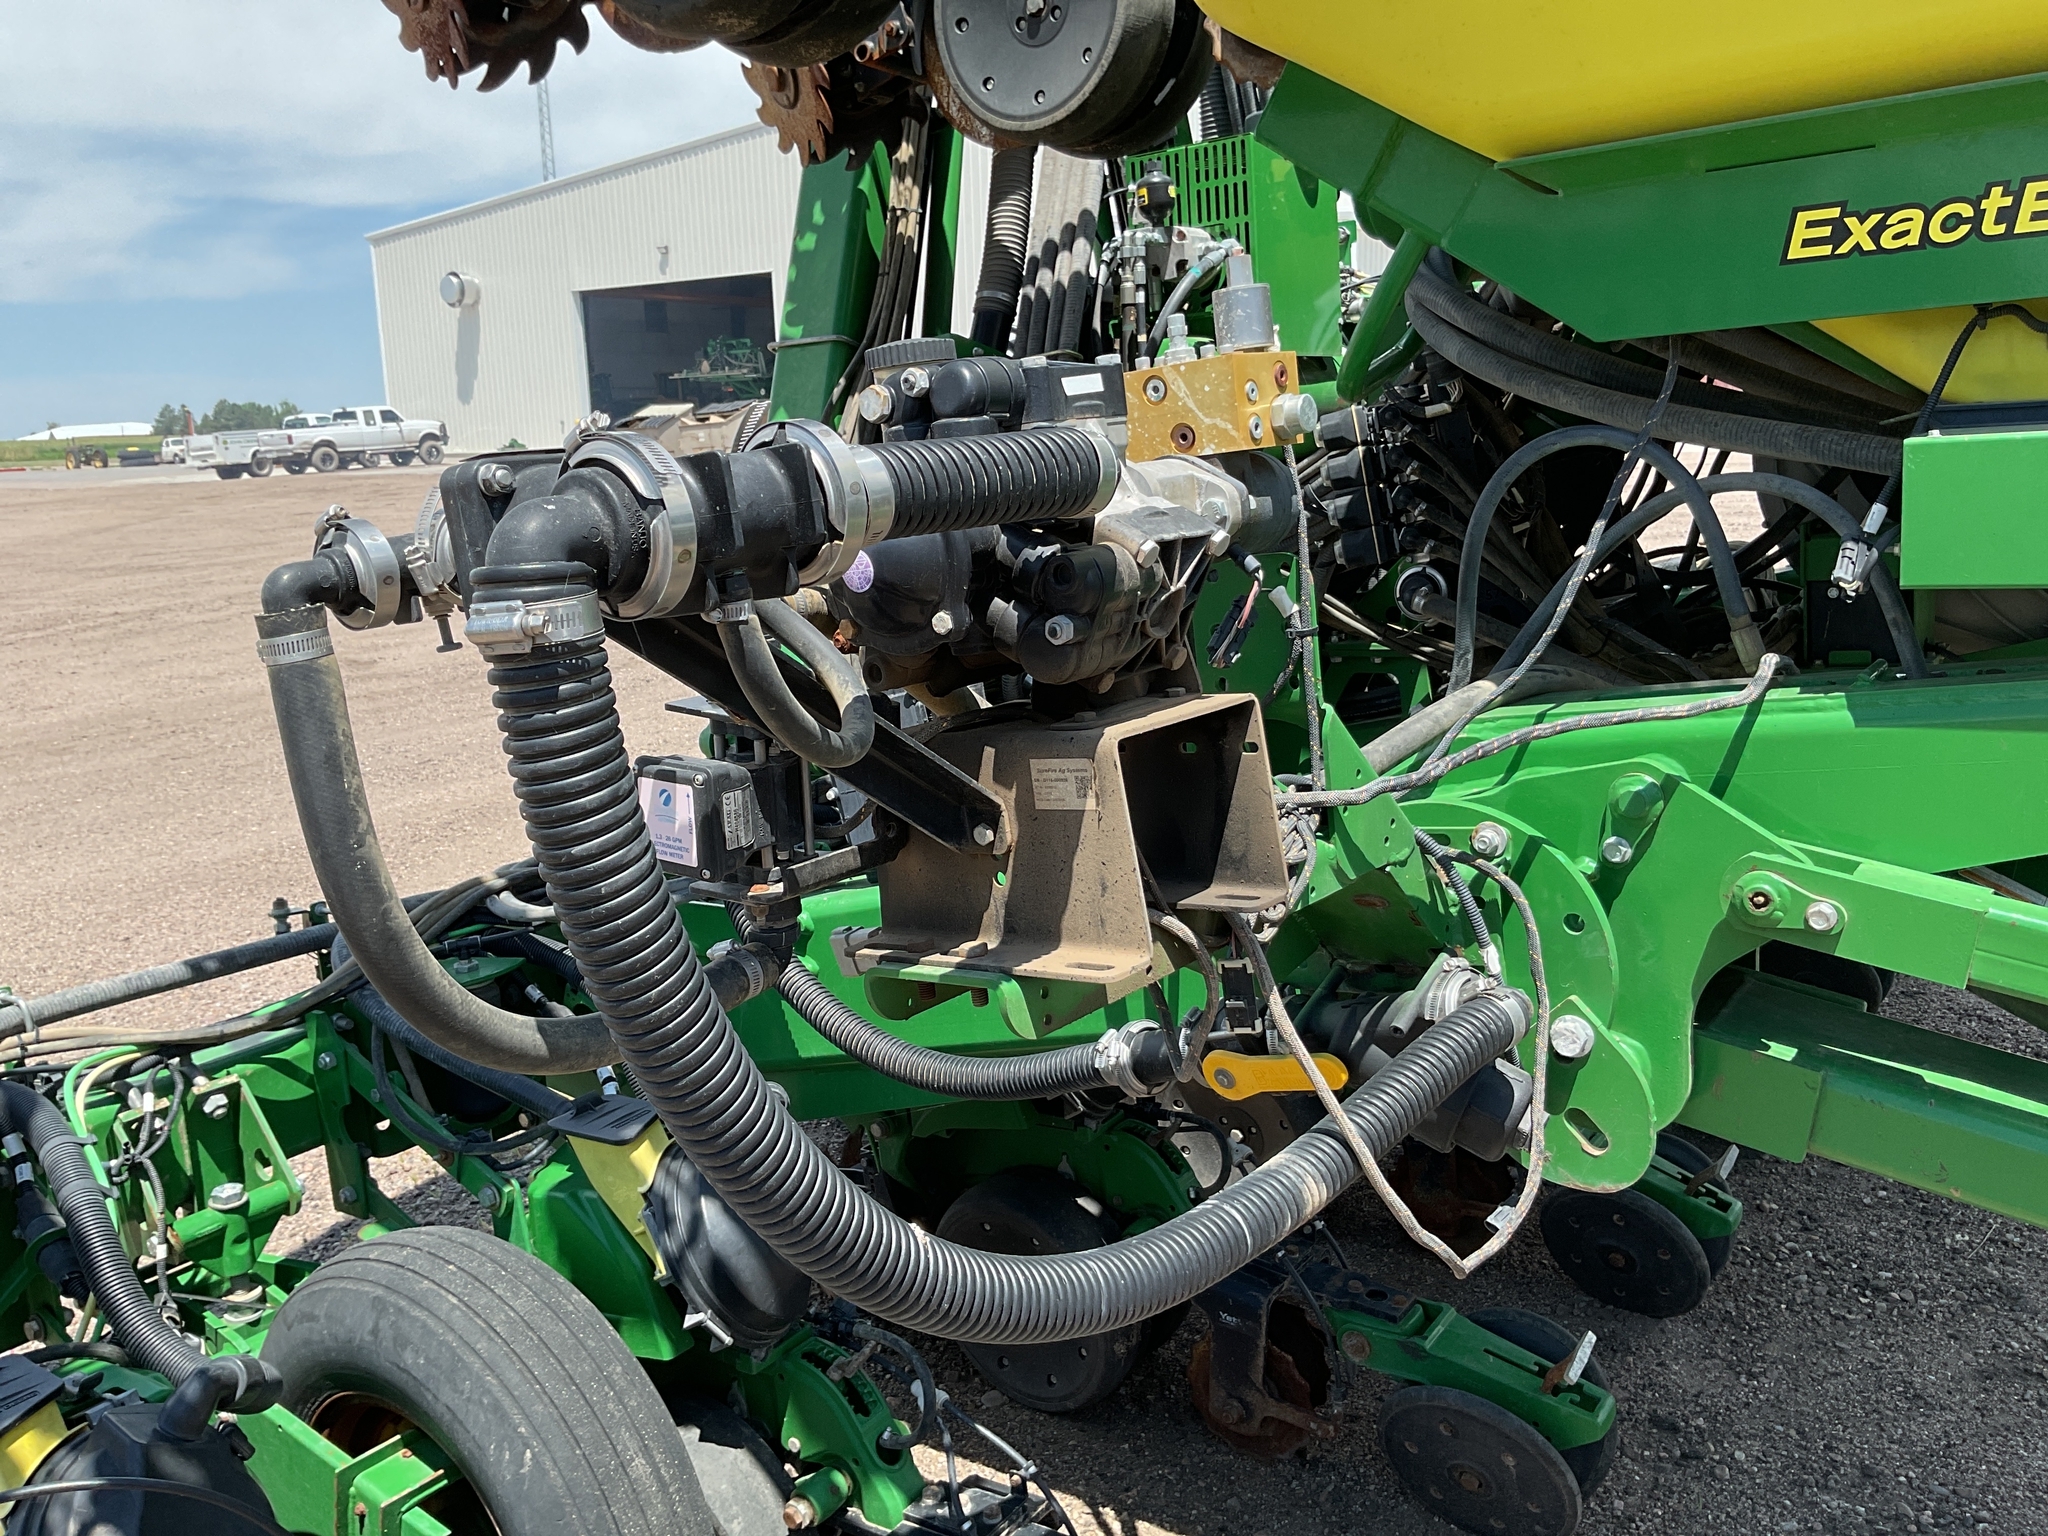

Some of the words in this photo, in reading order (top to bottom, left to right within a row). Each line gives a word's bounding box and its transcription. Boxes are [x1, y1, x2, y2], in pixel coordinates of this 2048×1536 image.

[634, 509, 647, 549] BANJO
[672, 836, 683, 844] GPM
[654, 840, 690, 854] ECTROMAGNETIC
[669, 851, 684, 859] METER
